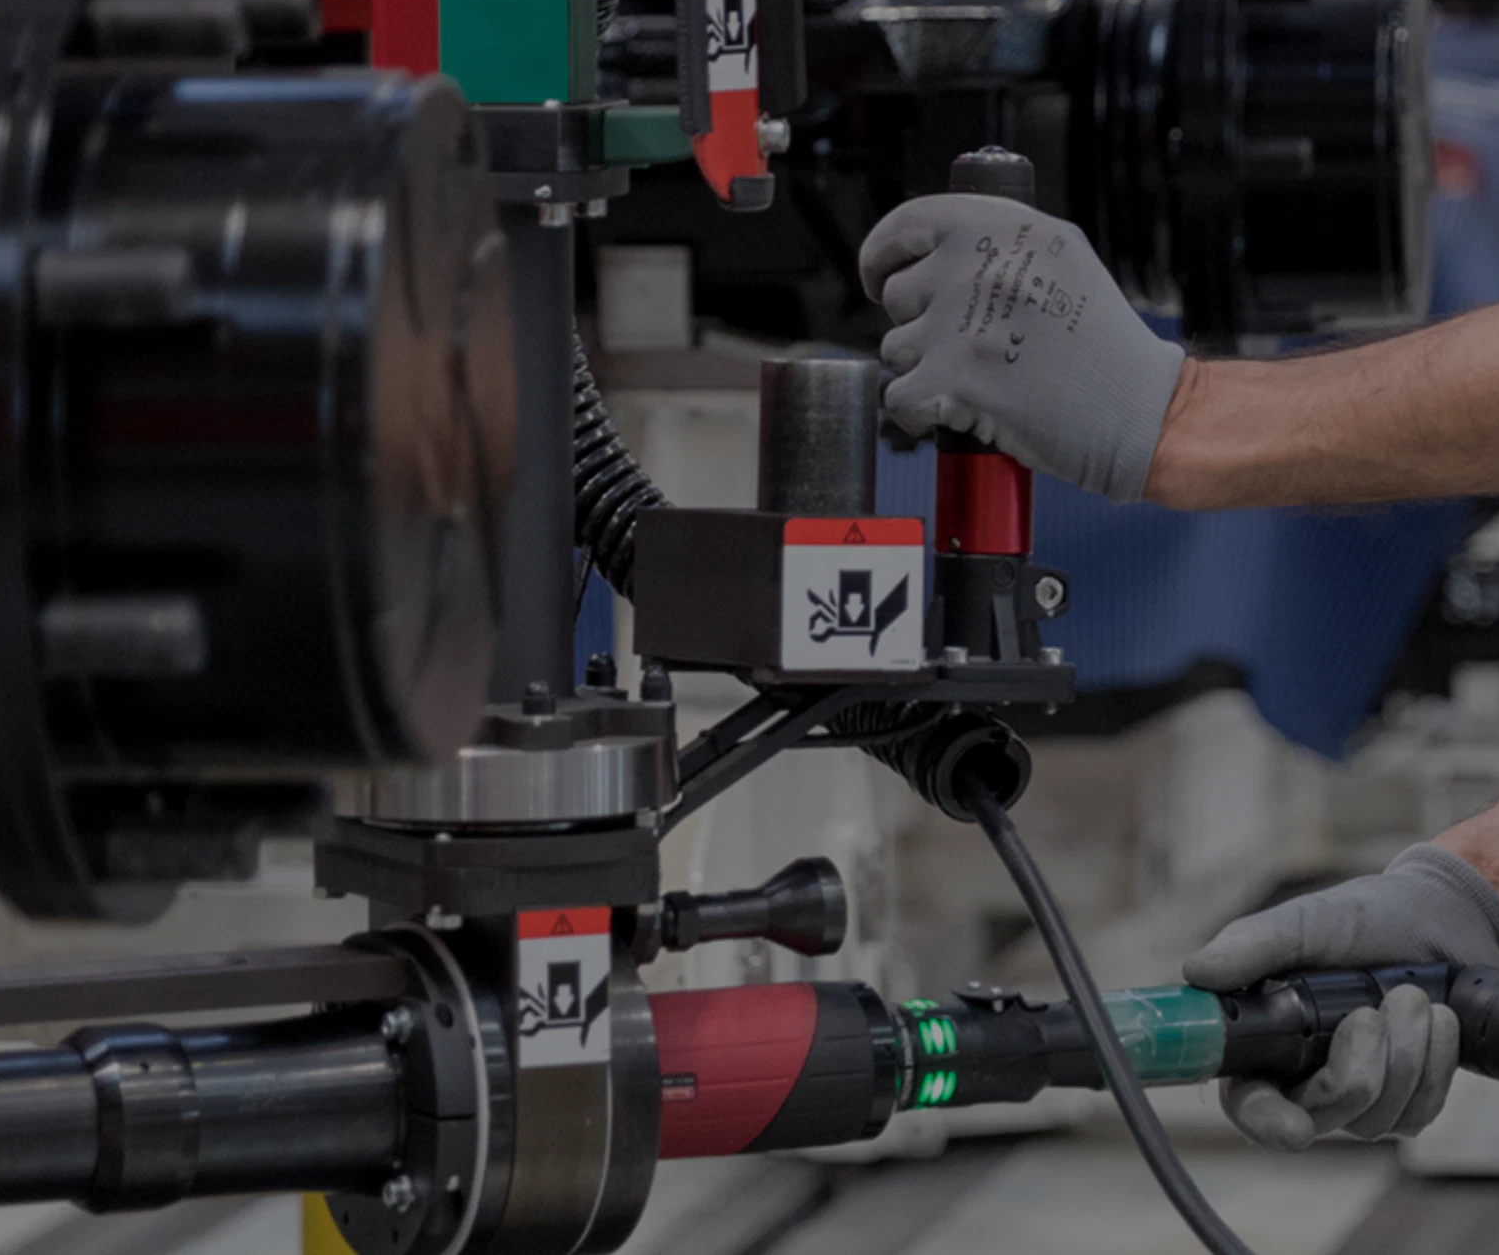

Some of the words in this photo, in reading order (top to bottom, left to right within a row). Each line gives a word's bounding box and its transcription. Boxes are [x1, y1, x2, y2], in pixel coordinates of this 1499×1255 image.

[1009, 222, 1033, 255] LITE
[1032, 276, 1044, 289] 9
[1004, 331, 1026, 363] CE
